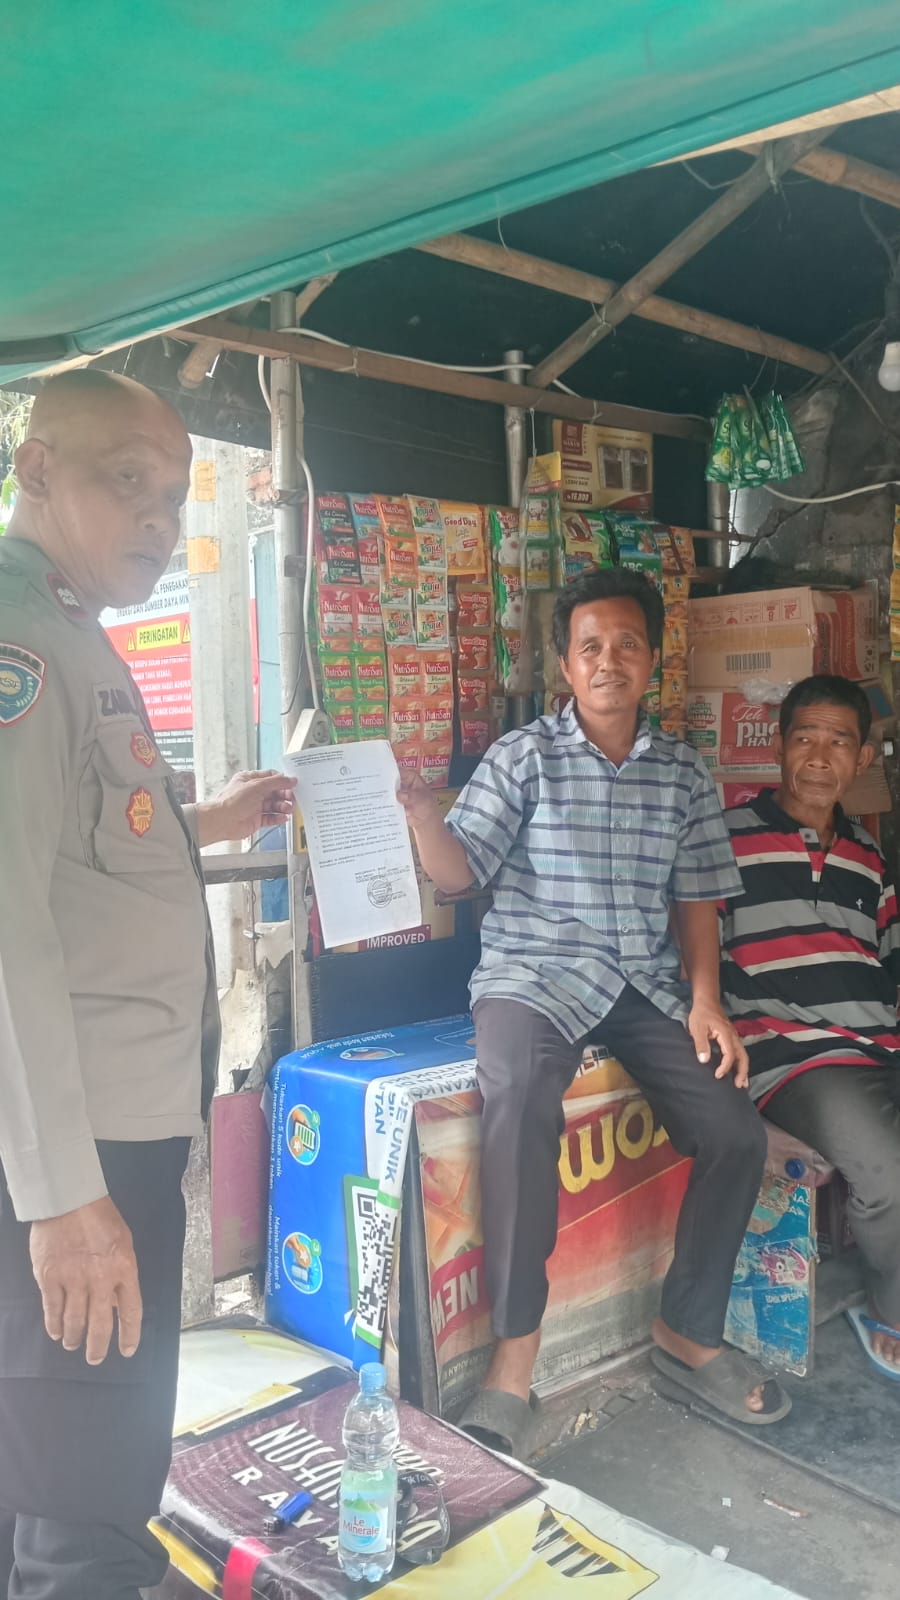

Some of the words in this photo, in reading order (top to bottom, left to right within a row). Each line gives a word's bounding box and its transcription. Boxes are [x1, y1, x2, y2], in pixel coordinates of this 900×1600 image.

[164, 596, 178, 608] DAYA
[140, 626, 178, 645] PERINGATAN
[732, 704, 763, 722] Teh
[366, 932, 426, 948] IMPROVED
[278, 1082, 286, 1123] Tukarkan
[385, 1127, 404, 1184] UNIK
[432, 1266, 478, 1336] NEW
[343, 1520, 380, 1537] Minerale
[354, 1516, 365, 1526] Le
